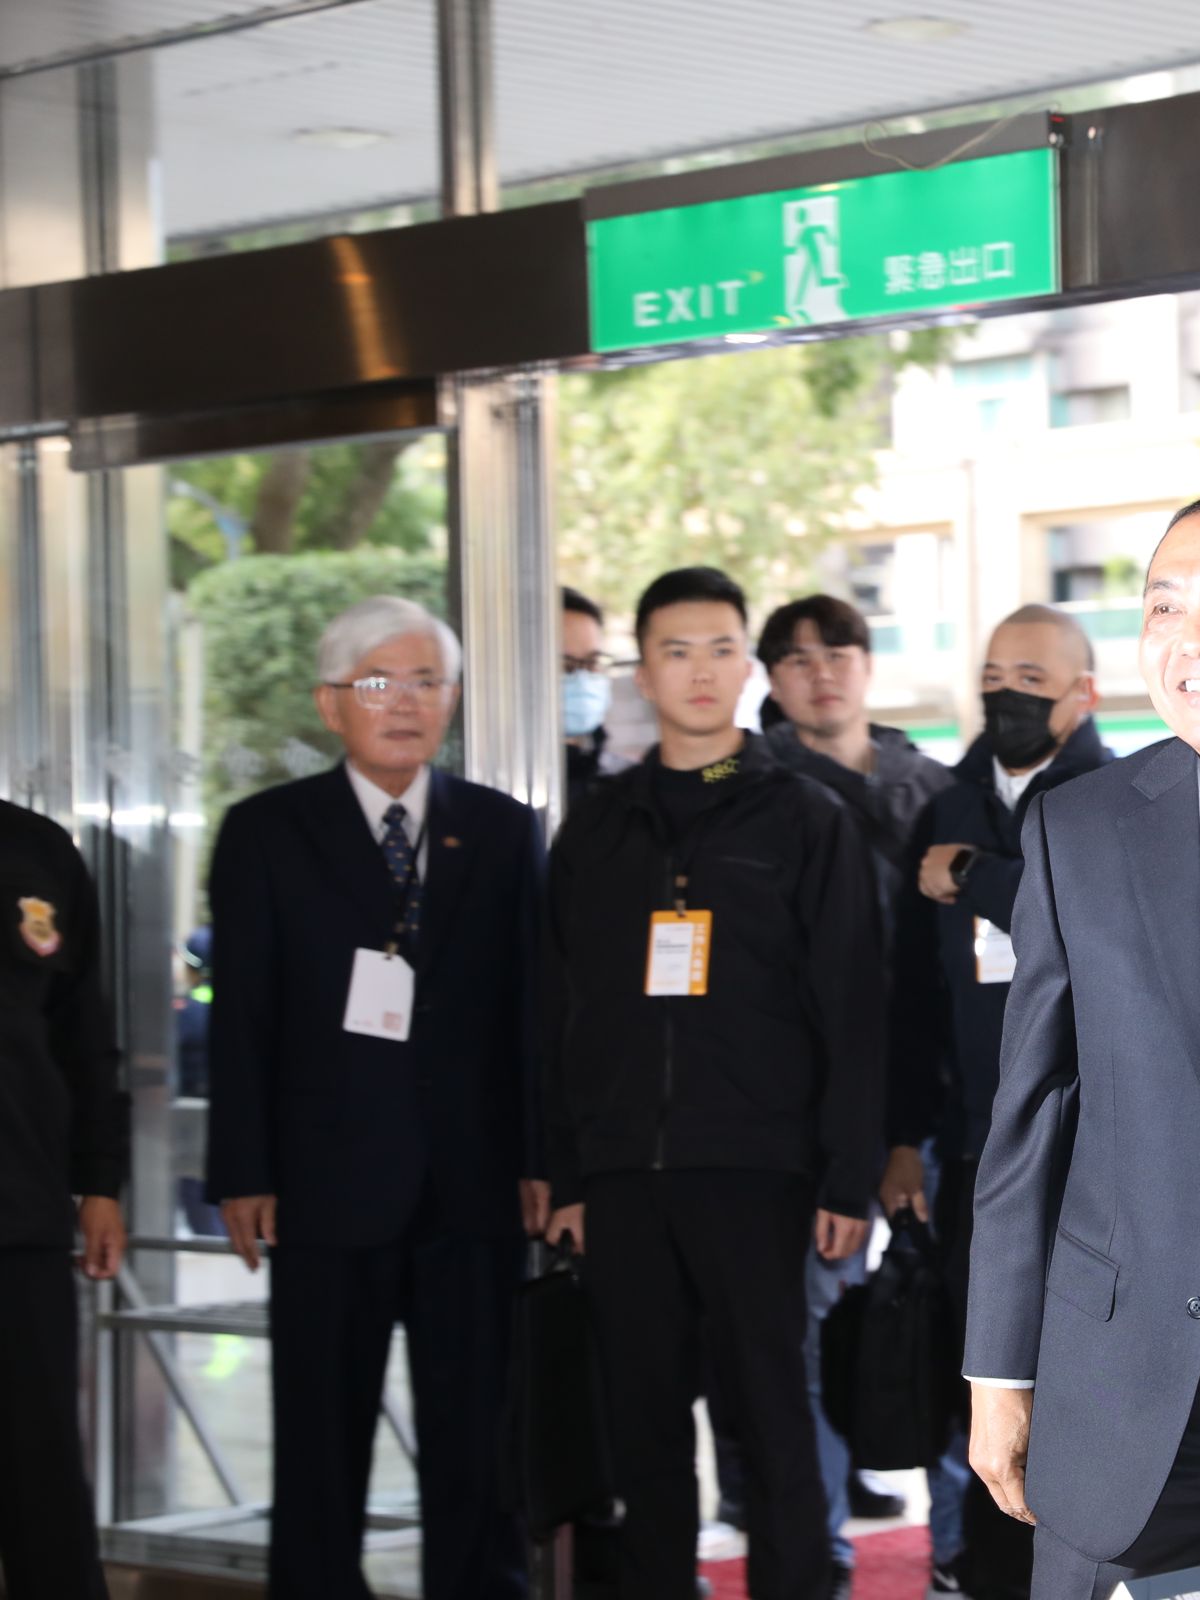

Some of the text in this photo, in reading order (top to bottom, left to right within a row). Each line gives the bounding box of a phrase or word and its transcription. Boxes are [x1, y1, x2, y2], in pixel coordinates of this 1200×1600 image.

[883, 241, 1015, 295] 緊急出口
[633, 279, 746, 327] EXIT
